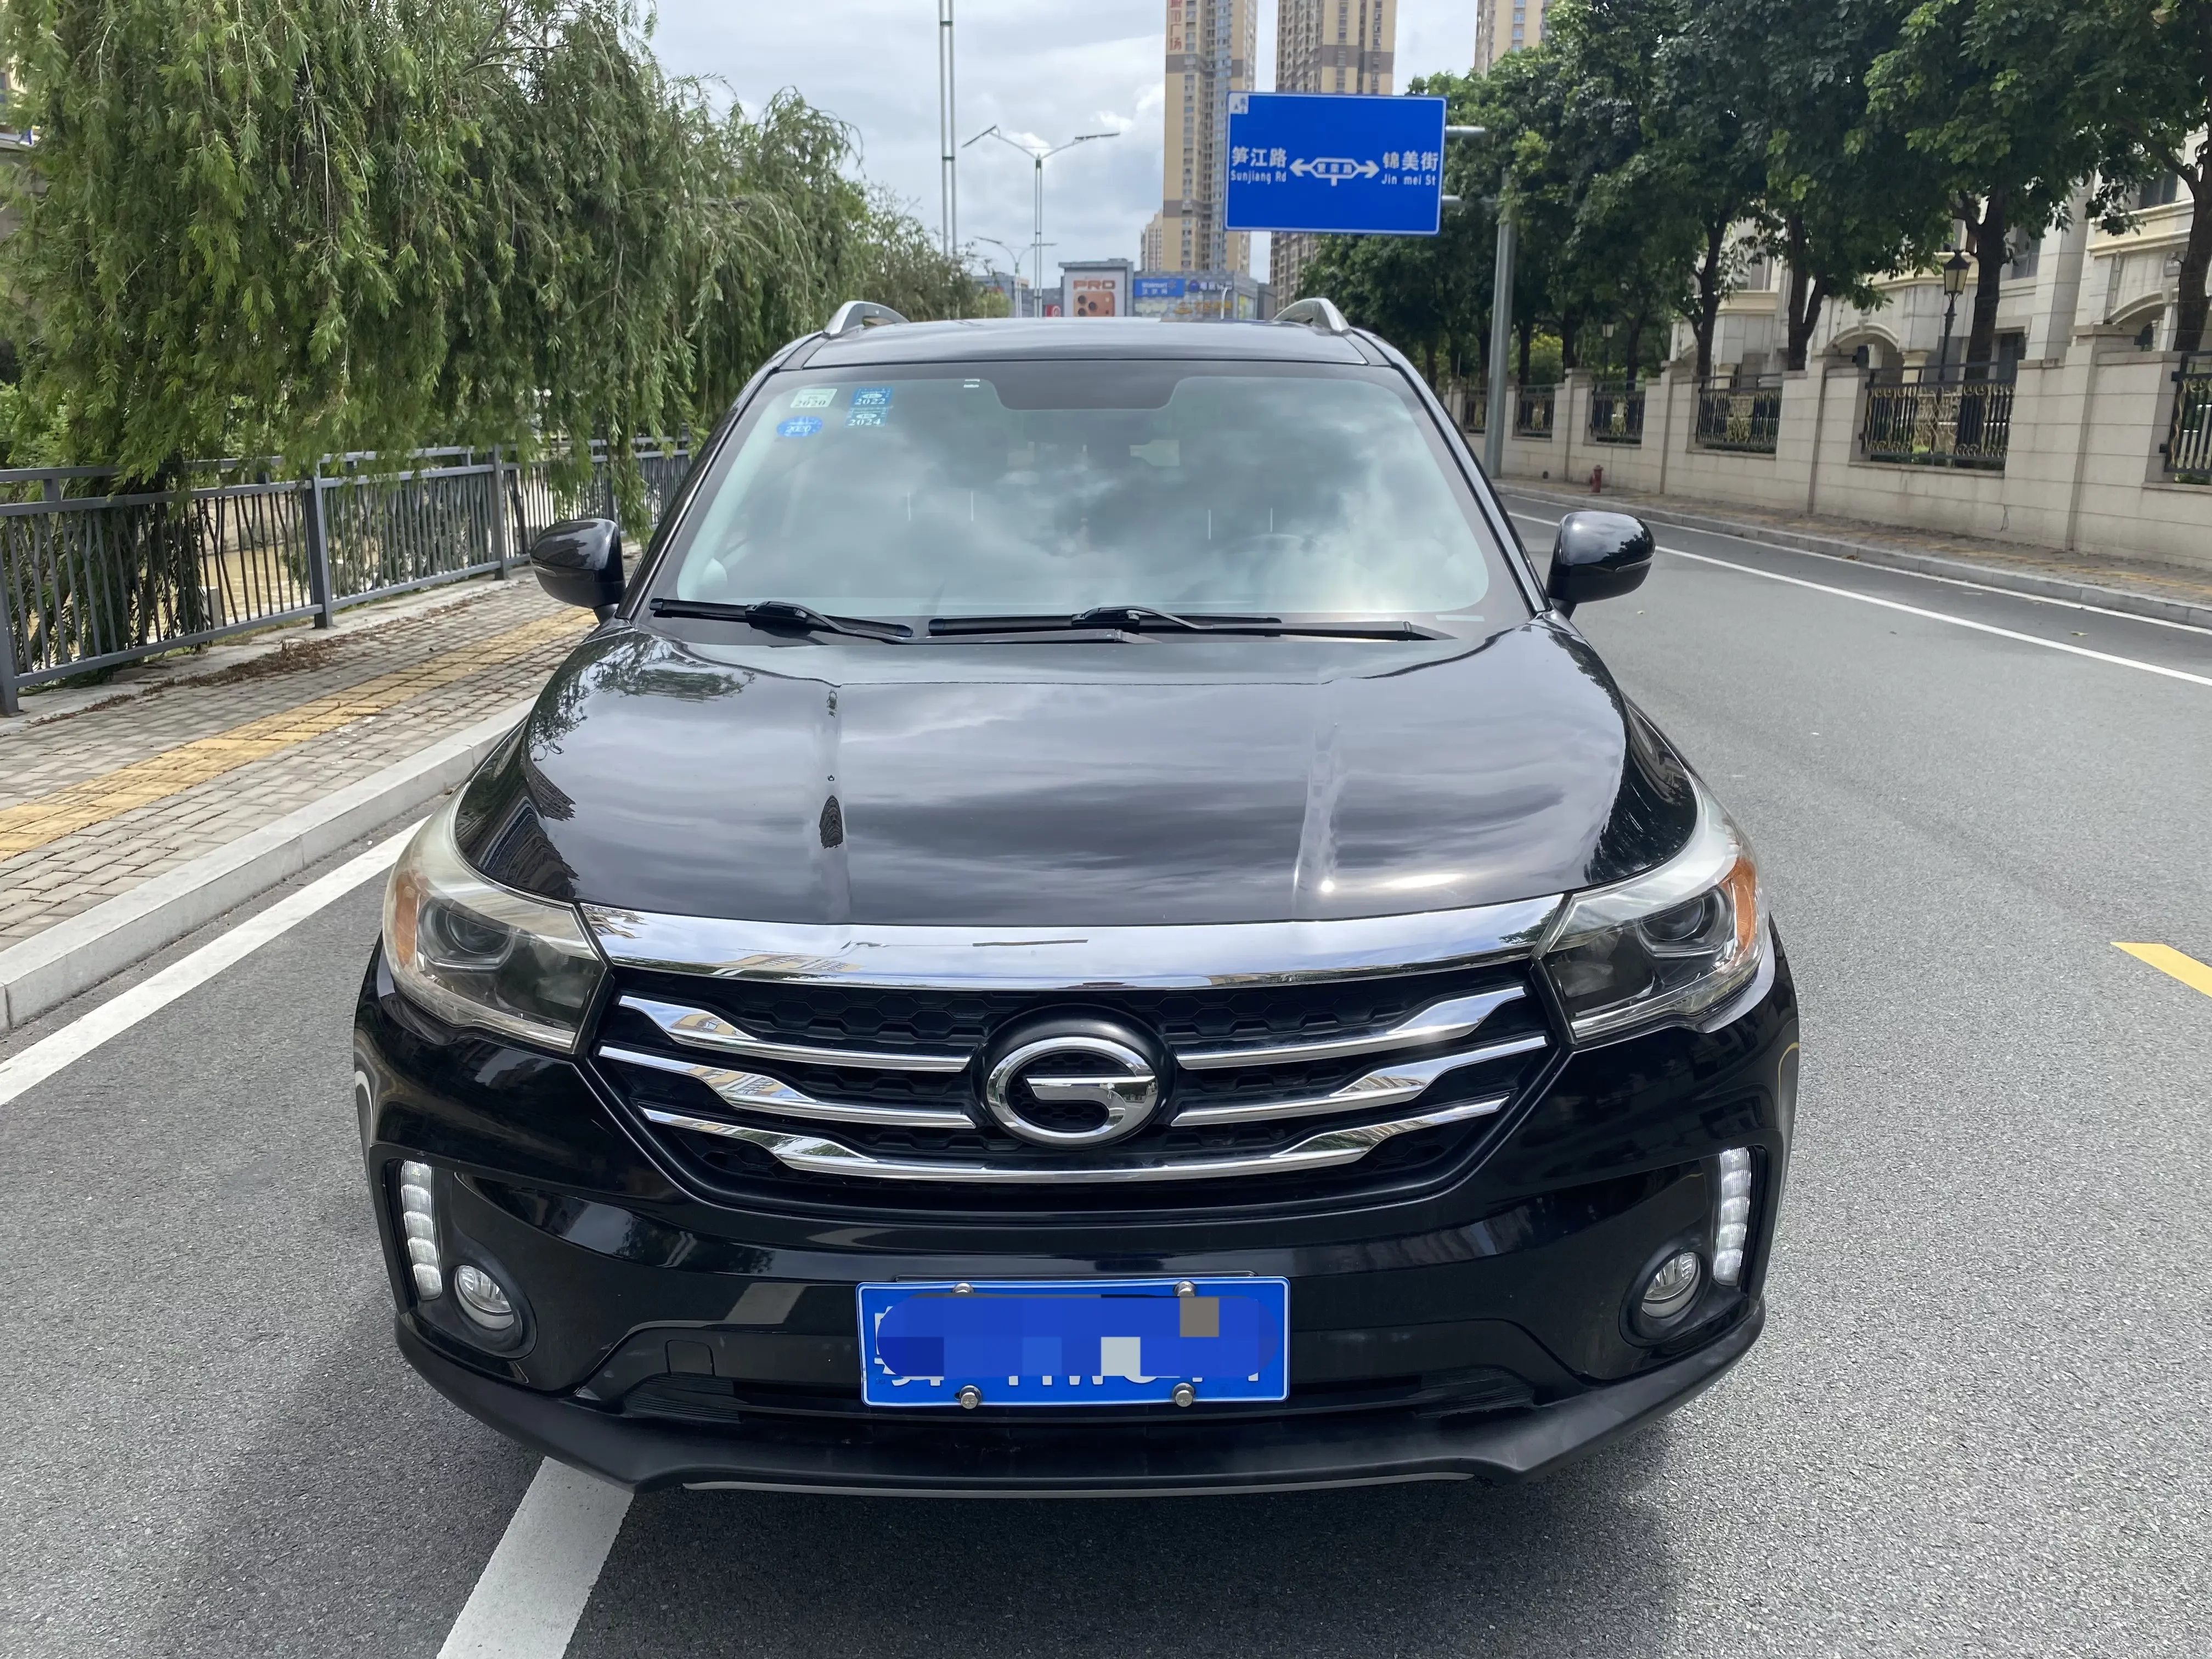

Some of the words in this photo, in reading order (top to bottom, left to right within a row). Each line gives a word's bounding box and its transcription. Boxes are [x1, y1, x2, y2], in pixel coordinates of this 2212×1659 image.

[1231, 146, 1287, 168] 笋江路
[1382, 150, 1439, 172] 锦美街
[1230, 170, 1272, 185] Sunjiang
[1275, 171, 1287, 183] Rd
[1381, 174, 1397, 185] Jin
[1403, 174, 1421, 185] mei
[1425, 174, 1436, 186] St
[847, 417, 881, 426] 2024
